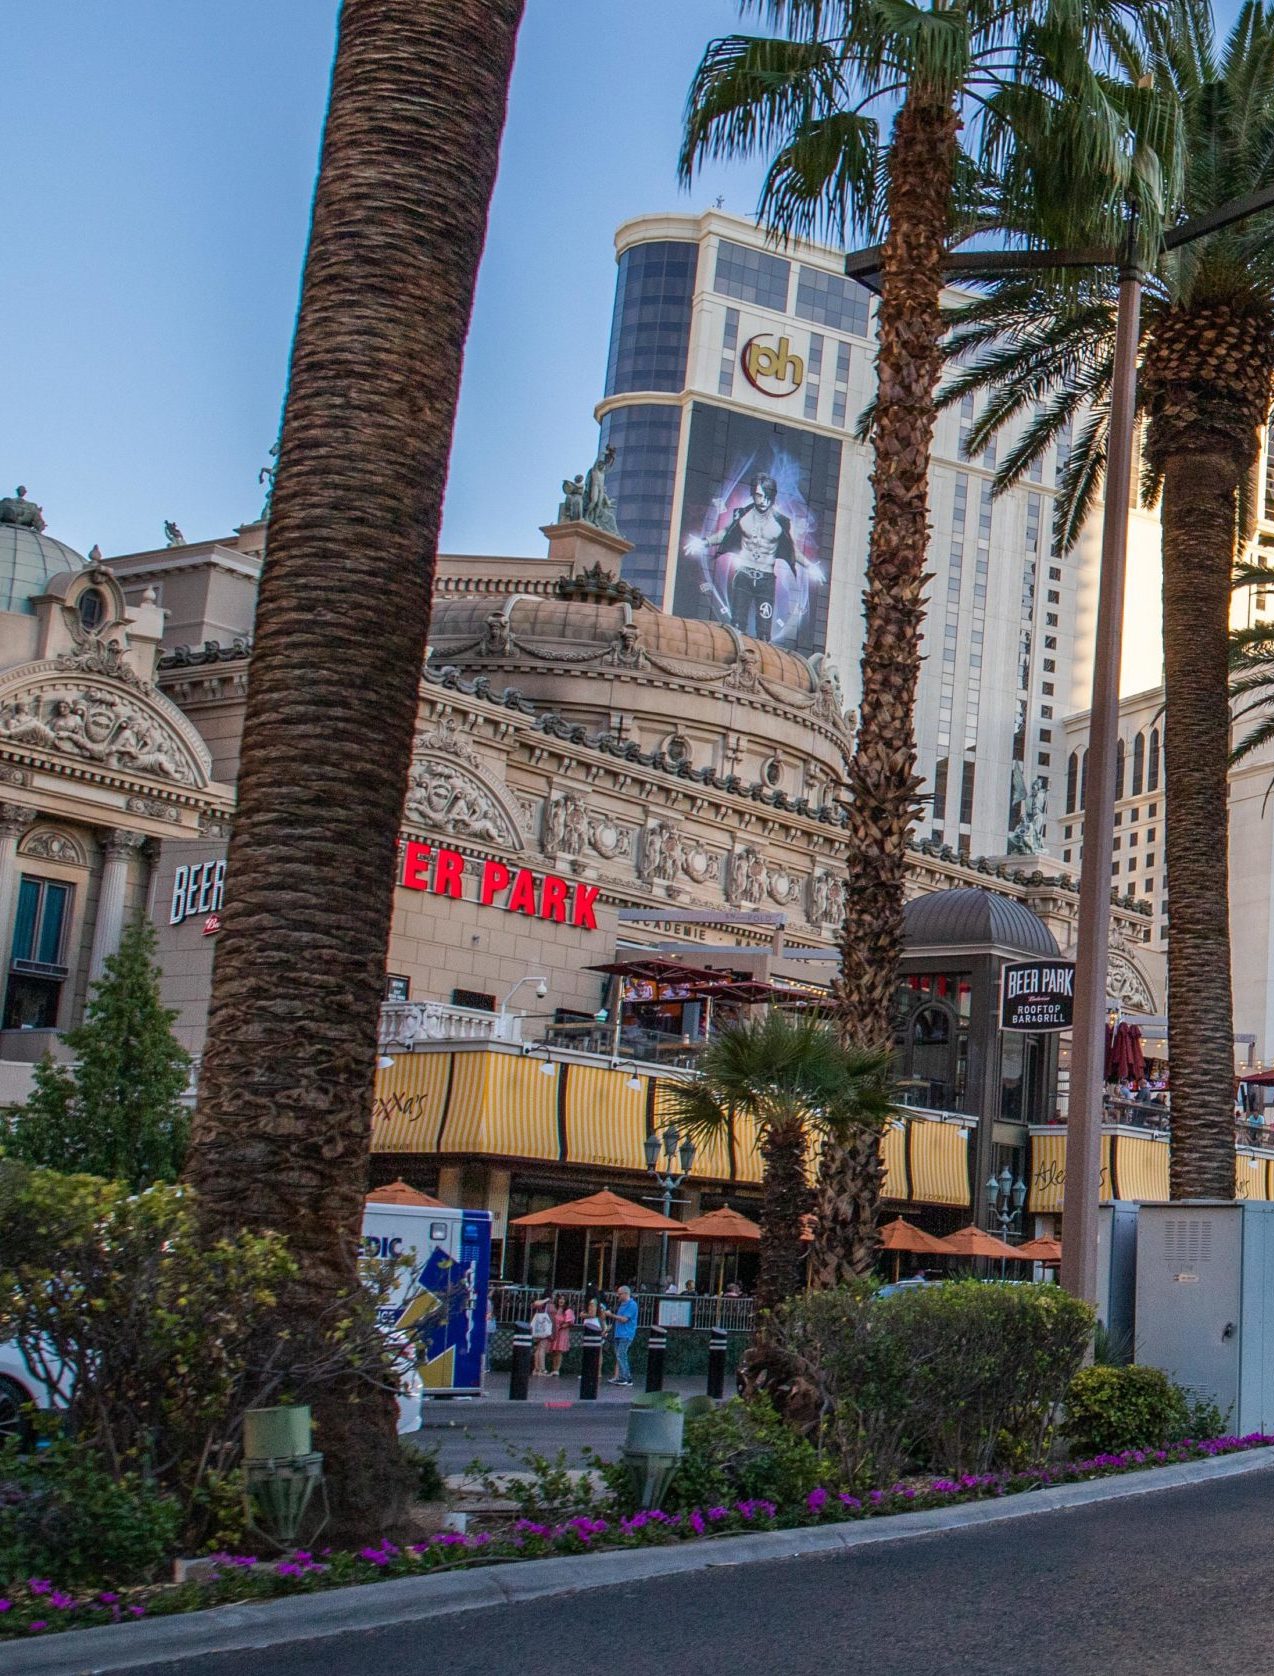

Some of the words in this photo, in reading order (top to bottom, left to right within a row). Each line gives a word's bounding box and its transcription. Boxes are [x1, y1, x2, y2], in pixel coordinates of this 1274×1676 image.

[170, 860, 227, 924] BEER
[396, 838, 464, 899] ER
[481, 859, 600, 929] PARK
[1008, 969, 1039, 999] BEER
[1042, 968, 1074, 996] PARK
[1018, 1004, 1061, 1014] ROOFTOP
